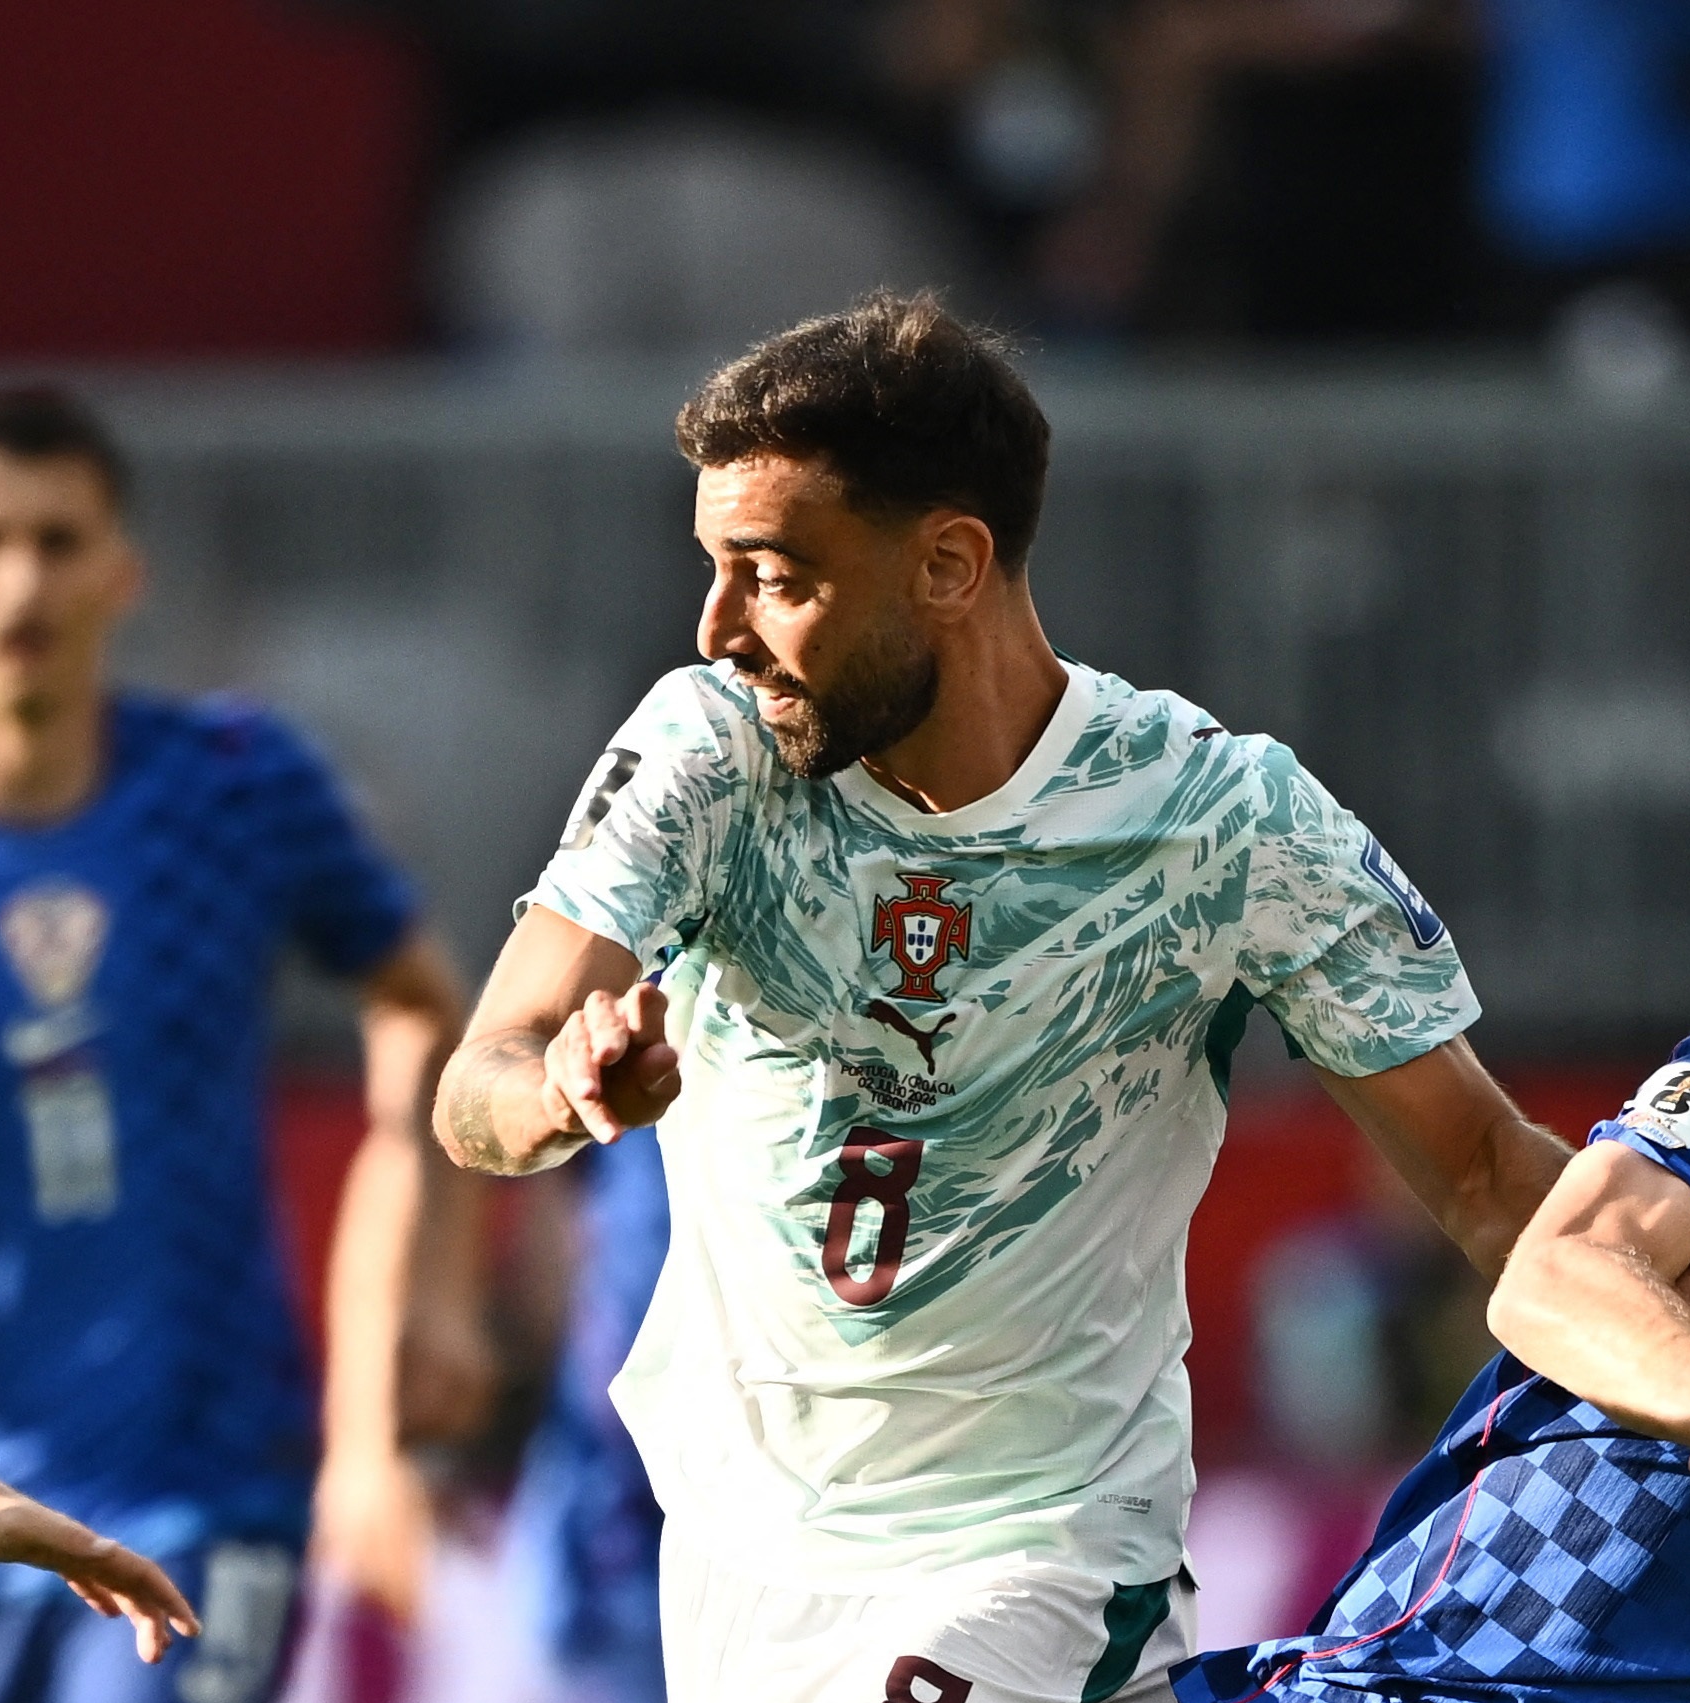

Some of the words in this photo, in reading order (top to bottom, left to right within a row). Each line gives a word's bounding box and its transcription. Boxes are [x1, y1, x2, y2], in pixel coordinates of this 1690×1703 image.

[857, 1077, 875, 1090] 02
[875, 1079, 907, 1098] JULHO
[908, 1089, 937, 1106] 2026
[871, 1091, 921, 1115] TORONTO
[821, 1126, 924, 1307] 8
